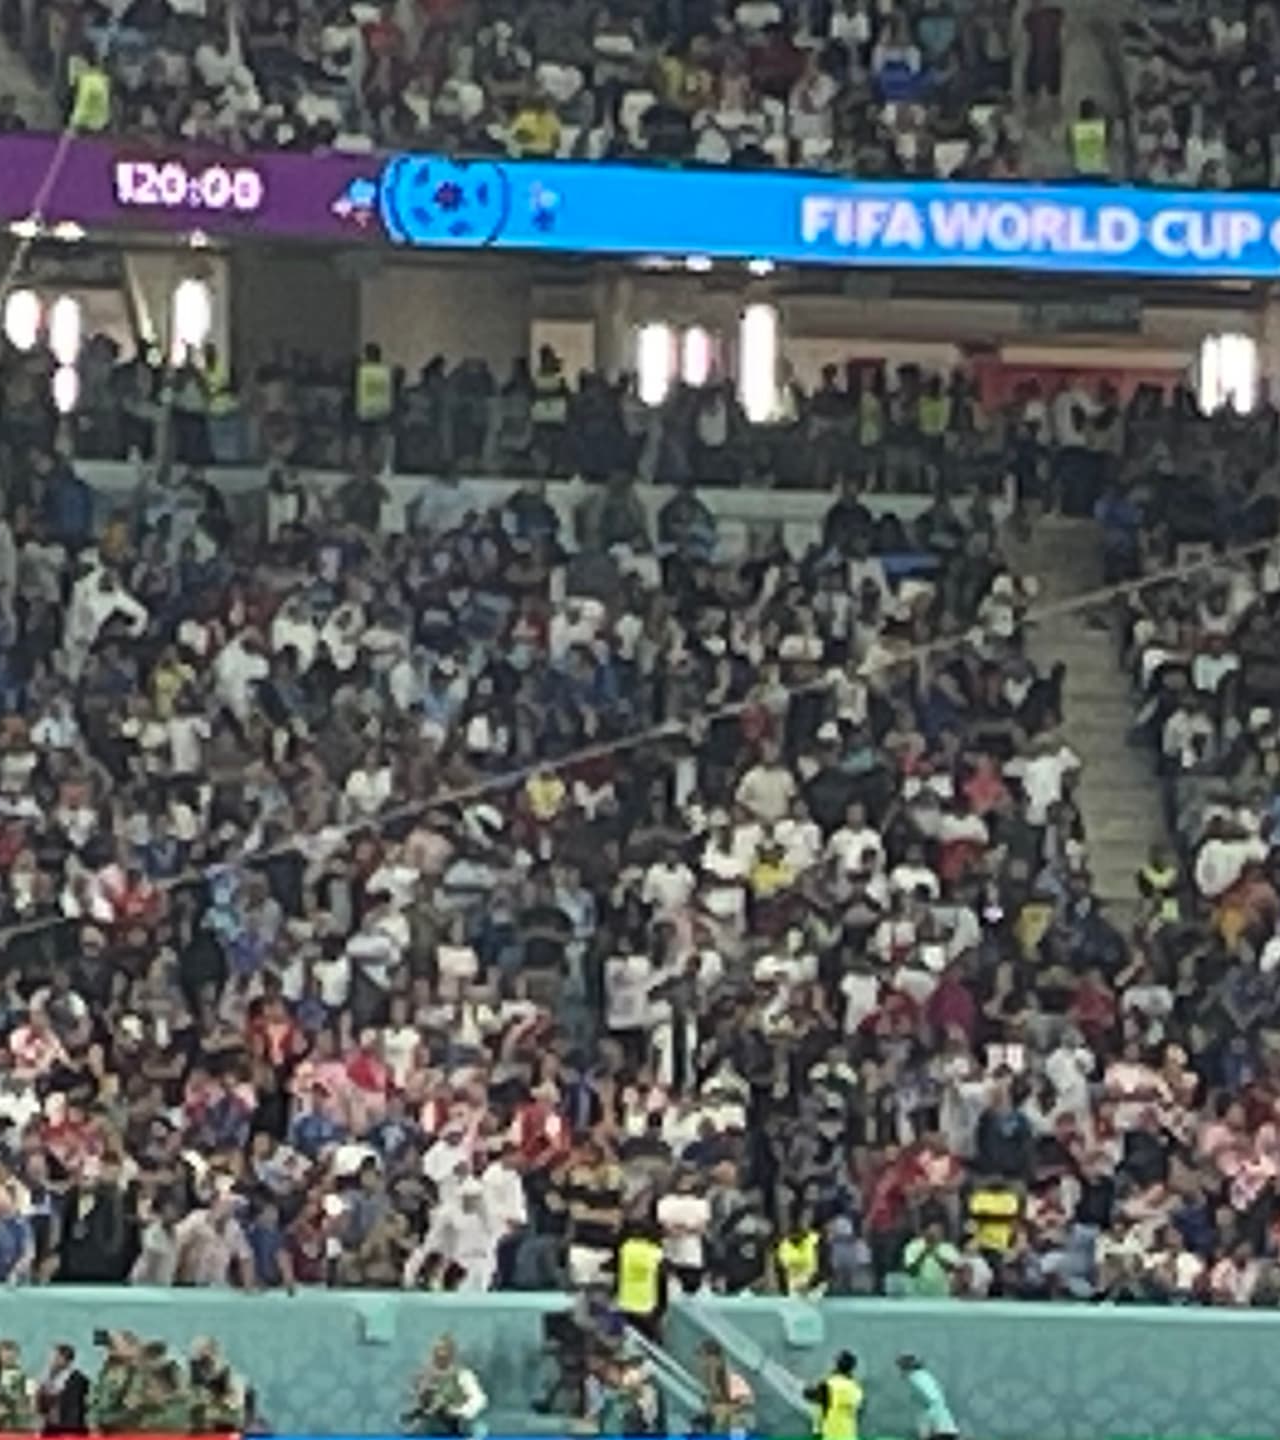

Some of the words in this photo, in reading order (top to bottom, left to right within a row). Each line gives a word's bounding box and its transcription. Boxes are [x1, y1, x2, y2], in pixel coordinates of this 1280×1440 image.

[116, 161, 264, 210] 120:00
[801, 196, 924, 249] FIFA
[931, 201, 1140, 255] WORLD
[1150, 206, 1262, 259] CUP
